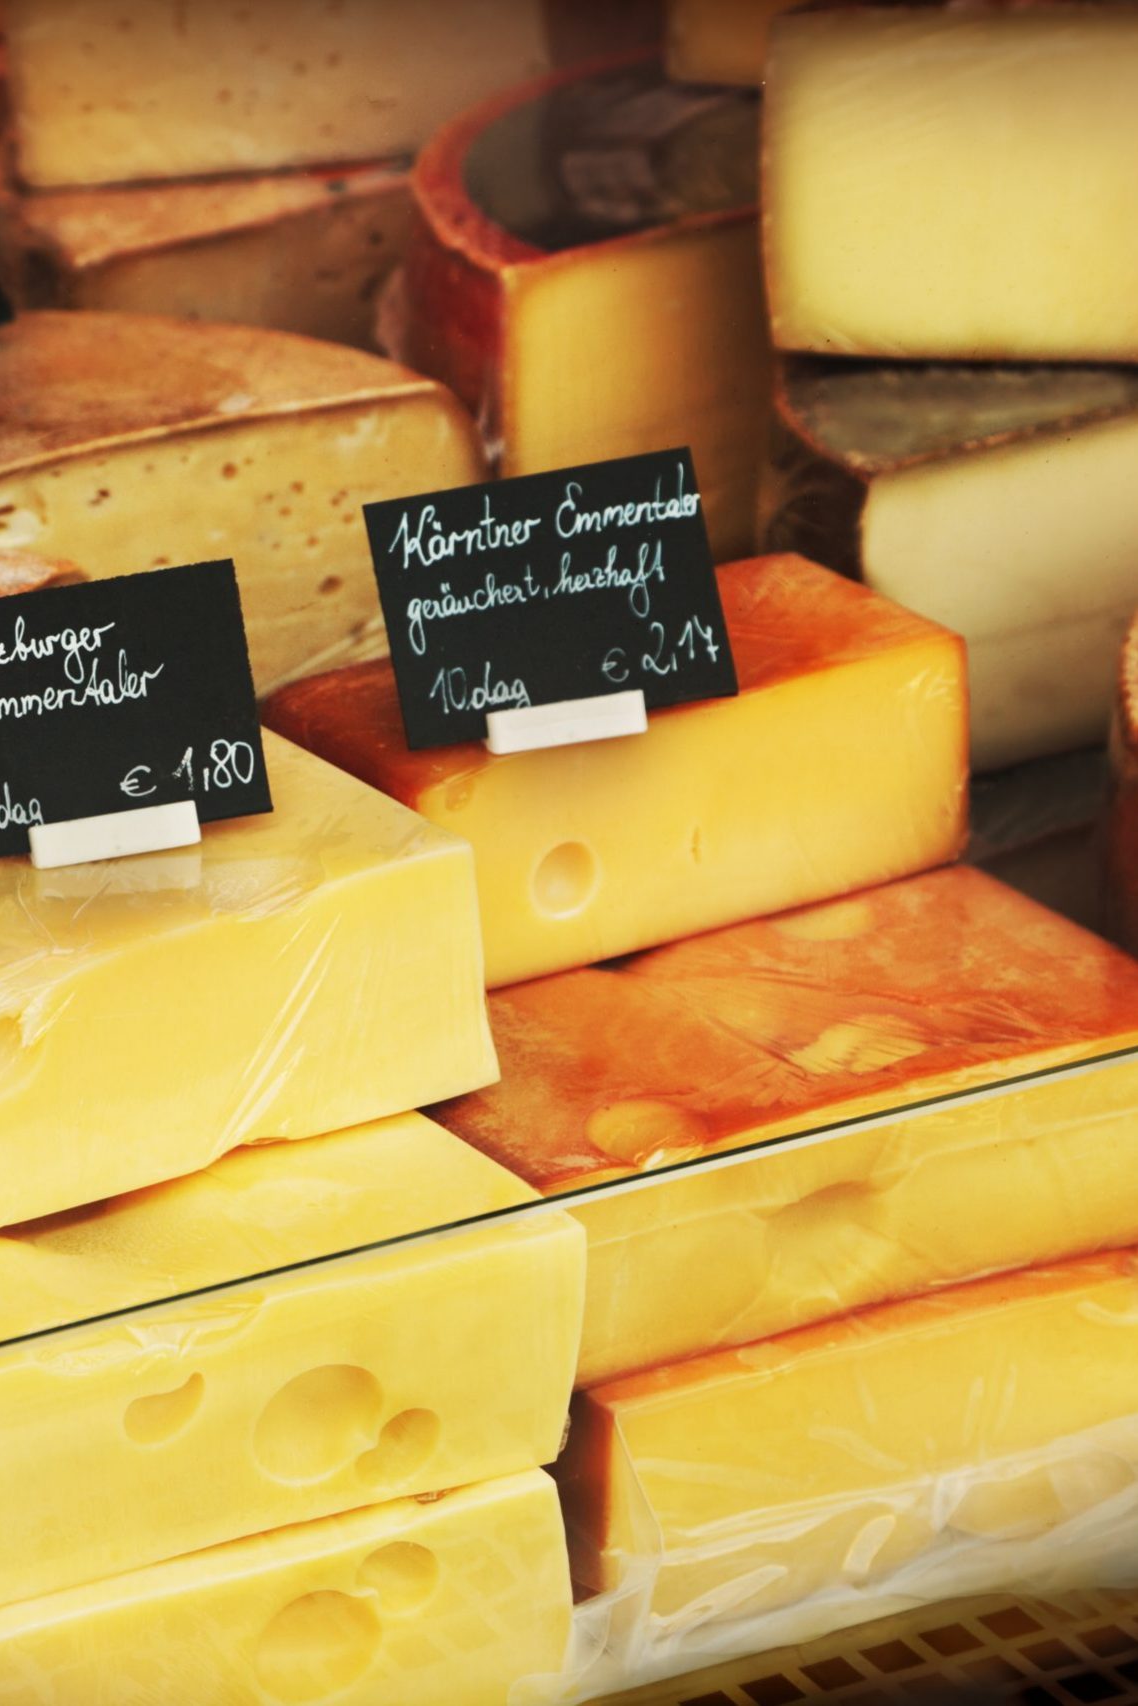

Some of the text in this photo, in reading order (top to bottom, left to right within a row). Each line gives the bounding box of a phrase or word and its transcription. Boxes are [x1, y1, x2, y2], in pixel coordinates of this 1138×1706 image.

[389, 462, 702, 569] Kärntner Emmentaler
[406, 539, 666, 656] geräuchert, herzhaft
[601, 647, 630, 683] €
[641, 615, 719, 676] 2,17
[119, 765, 158, 798] €
[171, 738, 255, 793] 1,80
